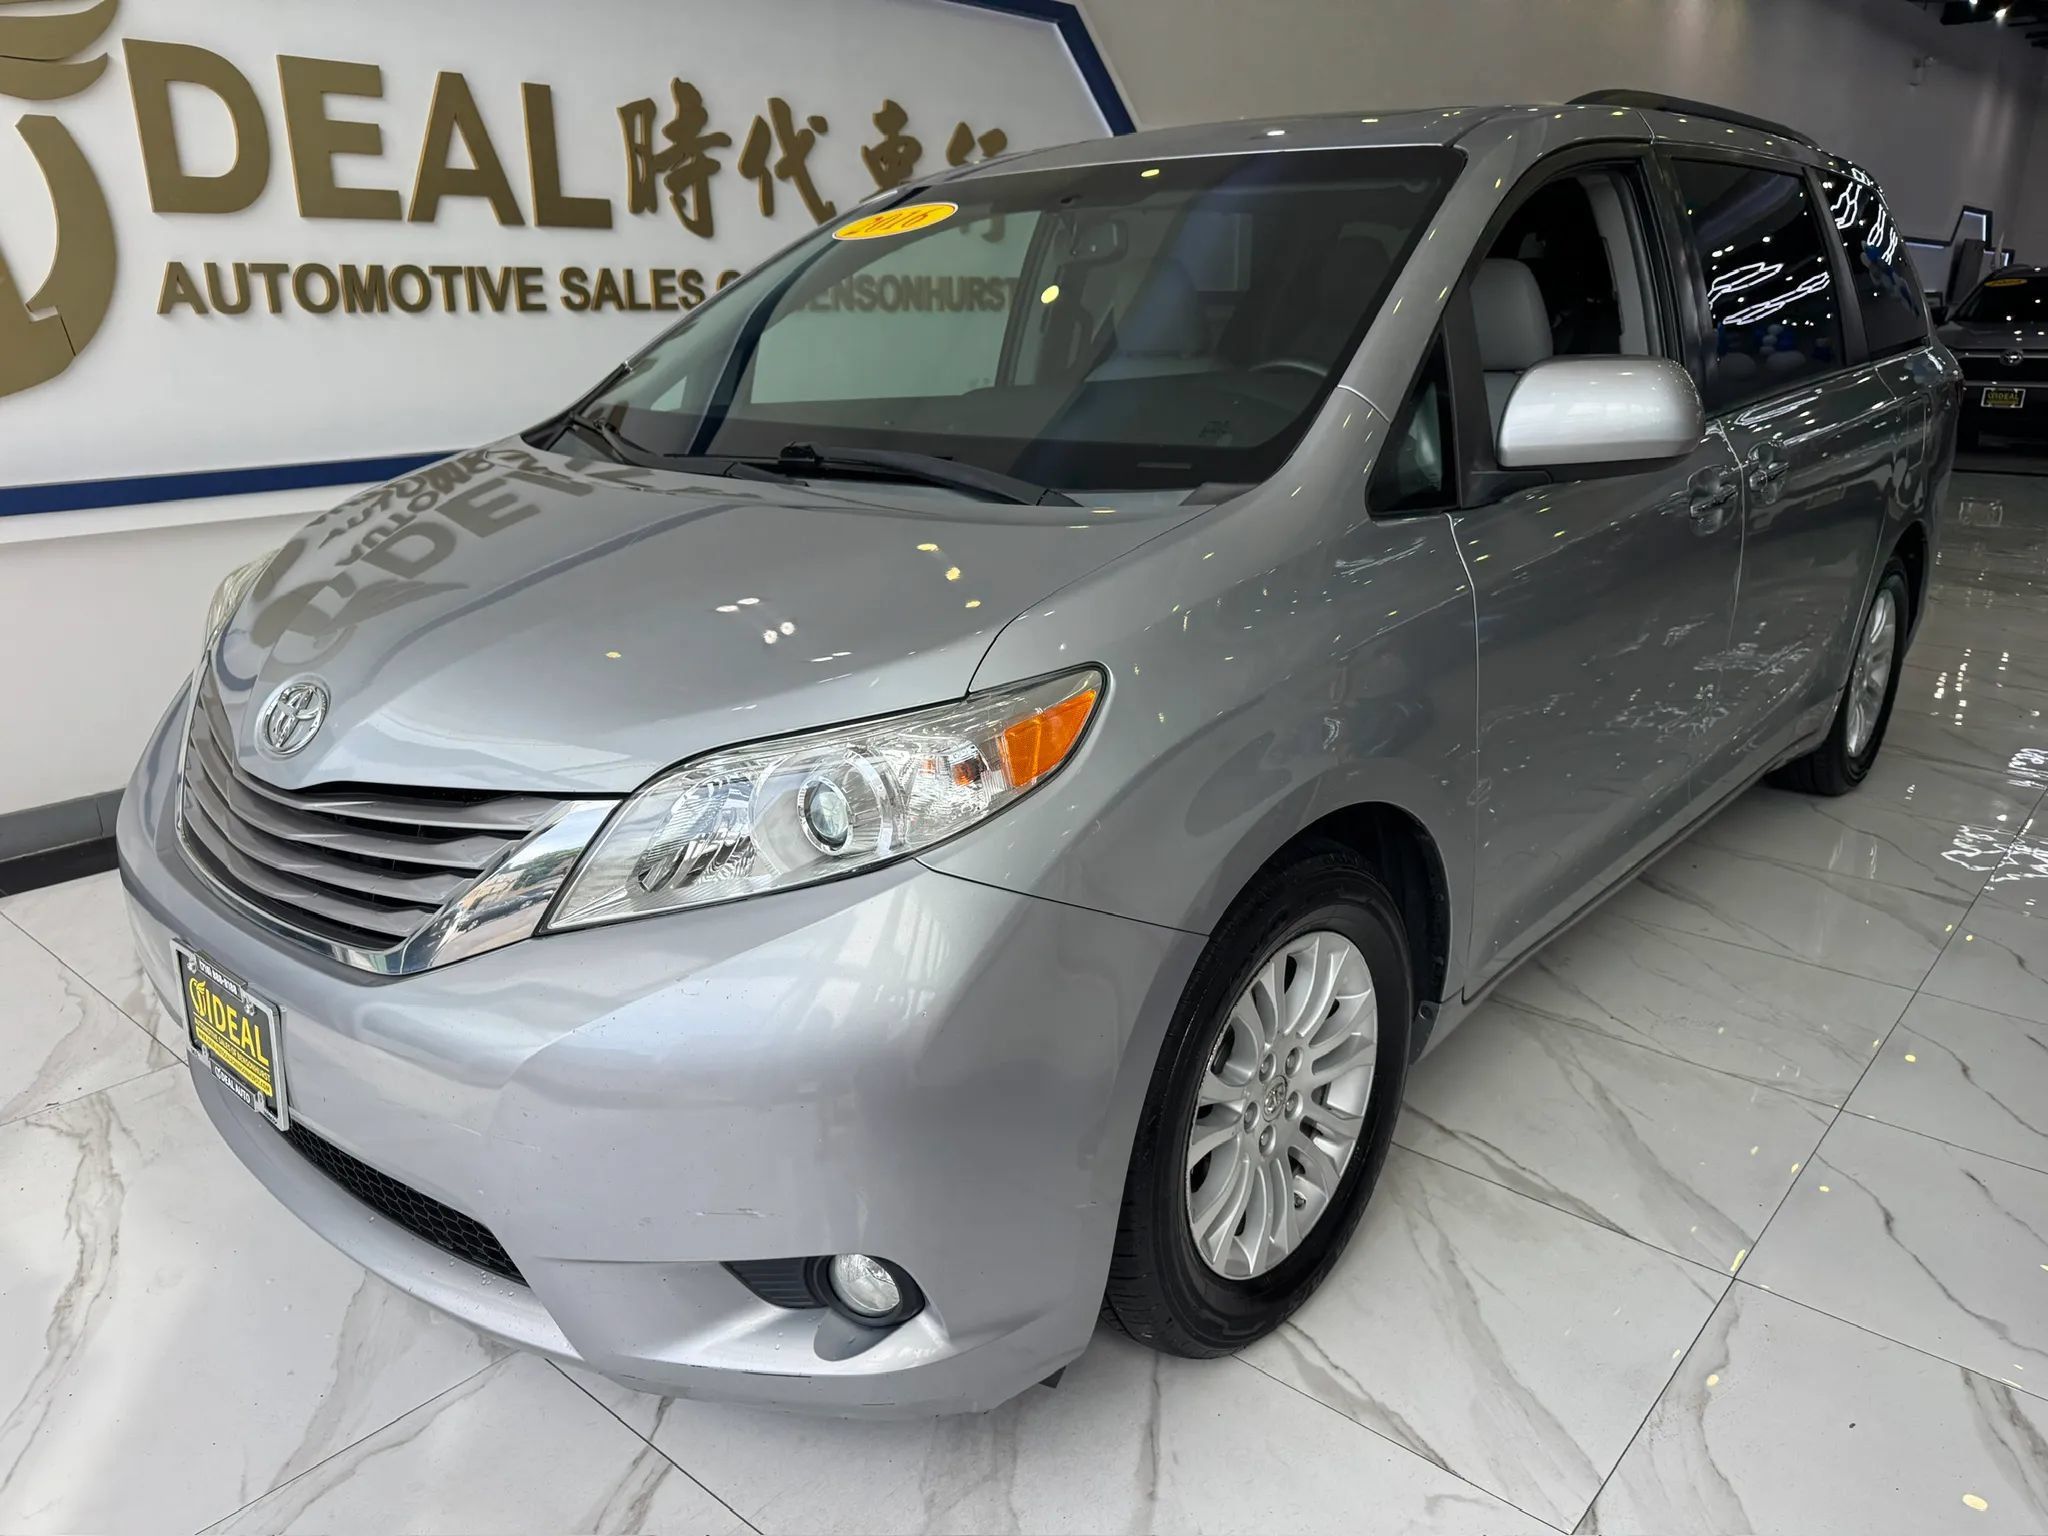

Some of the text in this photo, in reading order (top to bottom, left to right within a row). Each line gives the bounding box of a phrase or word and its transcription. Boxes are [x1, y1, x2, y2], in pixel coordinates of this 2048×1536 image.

[157, 261, 548, 314] AUTOMOTIVE
[560, 266, 706, 313] SALES
[206, 988, 269, 1067] IDEAL
